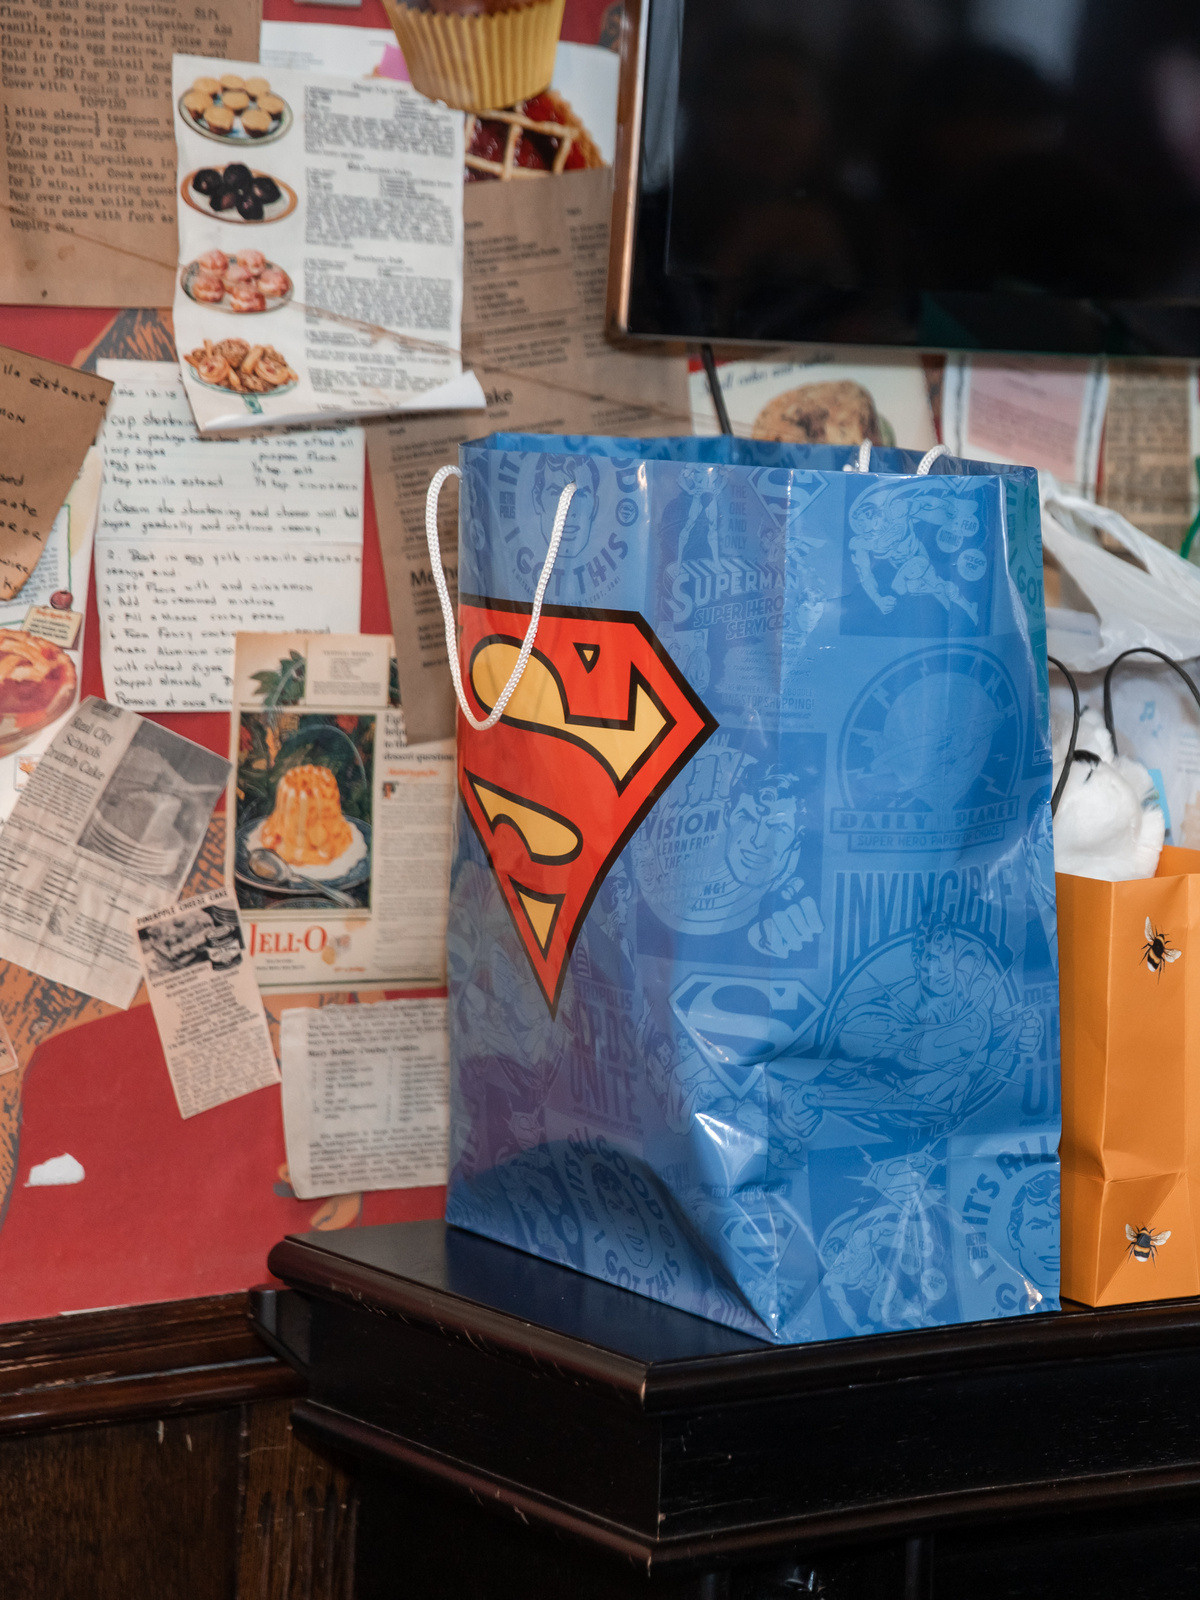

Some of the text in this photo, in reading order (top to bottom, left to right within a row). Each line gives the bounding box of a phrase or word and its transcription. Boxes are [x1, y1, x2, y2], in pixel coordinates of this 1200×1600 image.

[664, 558, 799, 625] SUPERMAN
[693, 594, 785, 628] SUPER HERO
[839, 813, 929, 830] DAILY
[857, 834, 894, 848] SUPER
[250, 923, 328, 957] JELL-O
